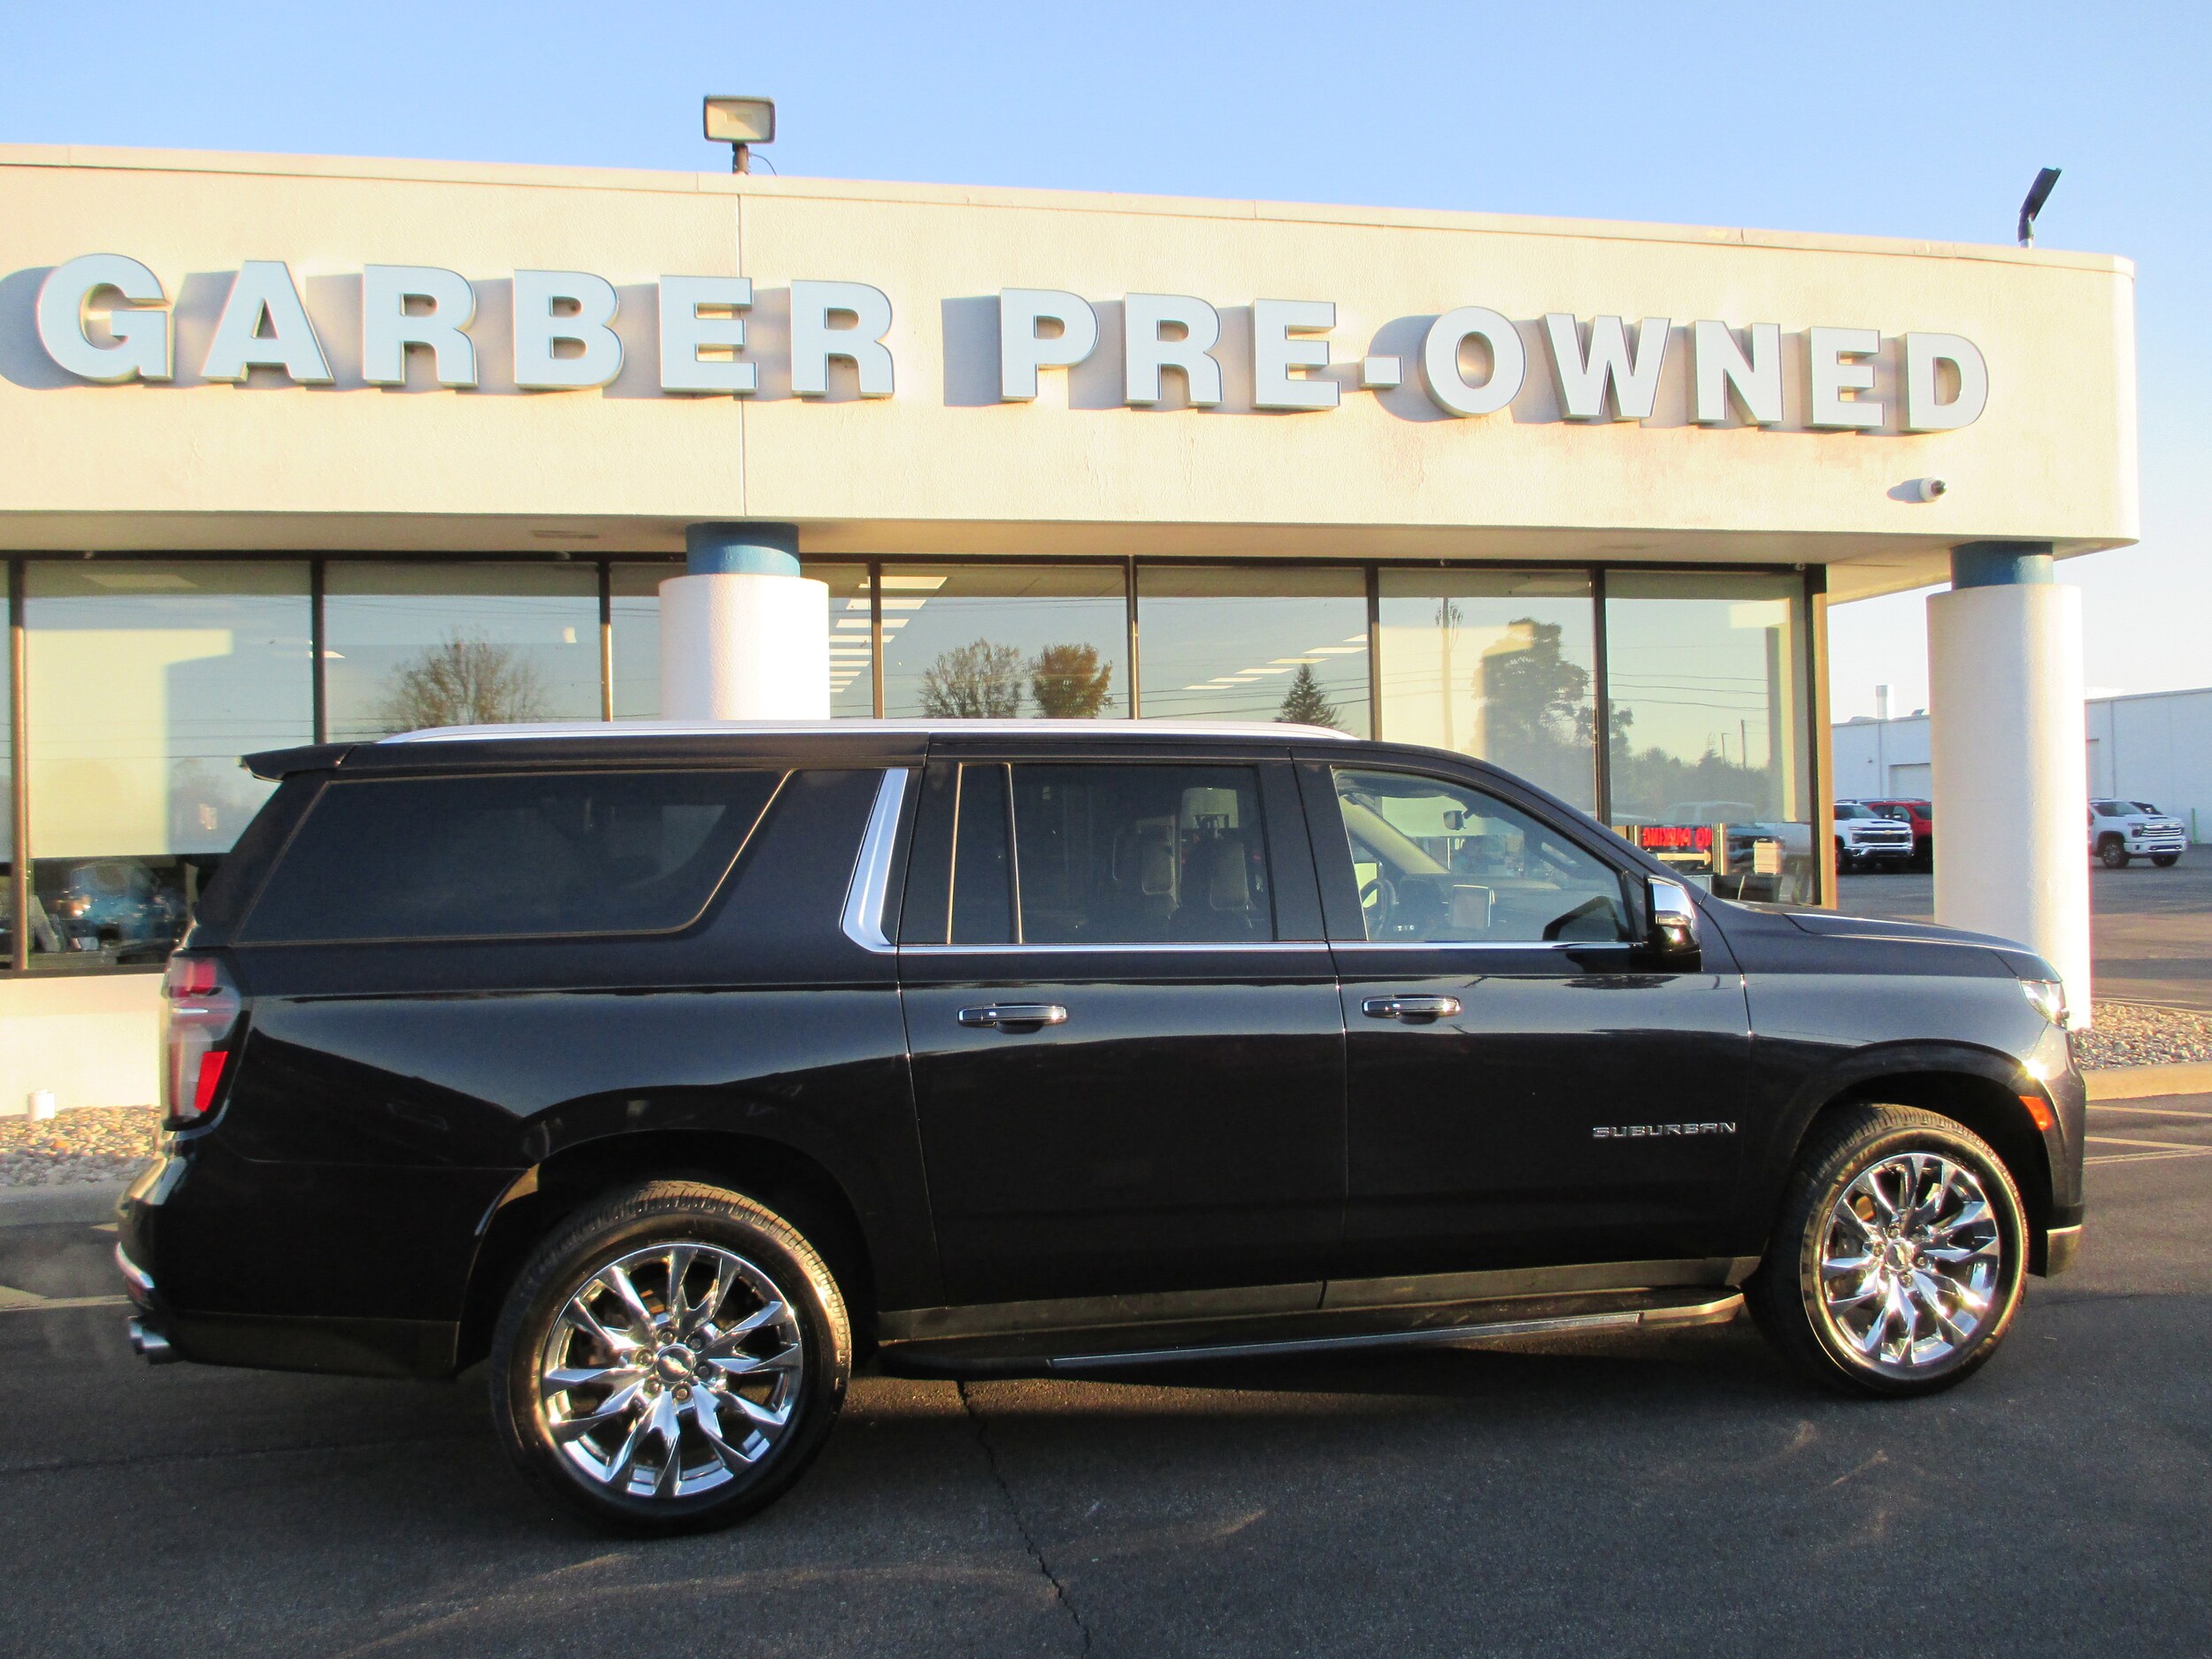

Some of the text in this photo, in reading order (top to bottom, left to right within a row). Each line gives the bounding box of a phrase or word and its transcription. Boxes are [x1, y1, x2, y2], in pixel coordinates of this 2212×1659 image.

[35, 253, 1989, 433] GARBER PRE-OWNED
[1592, 1121, 1737, 1138] SUBURBAN
